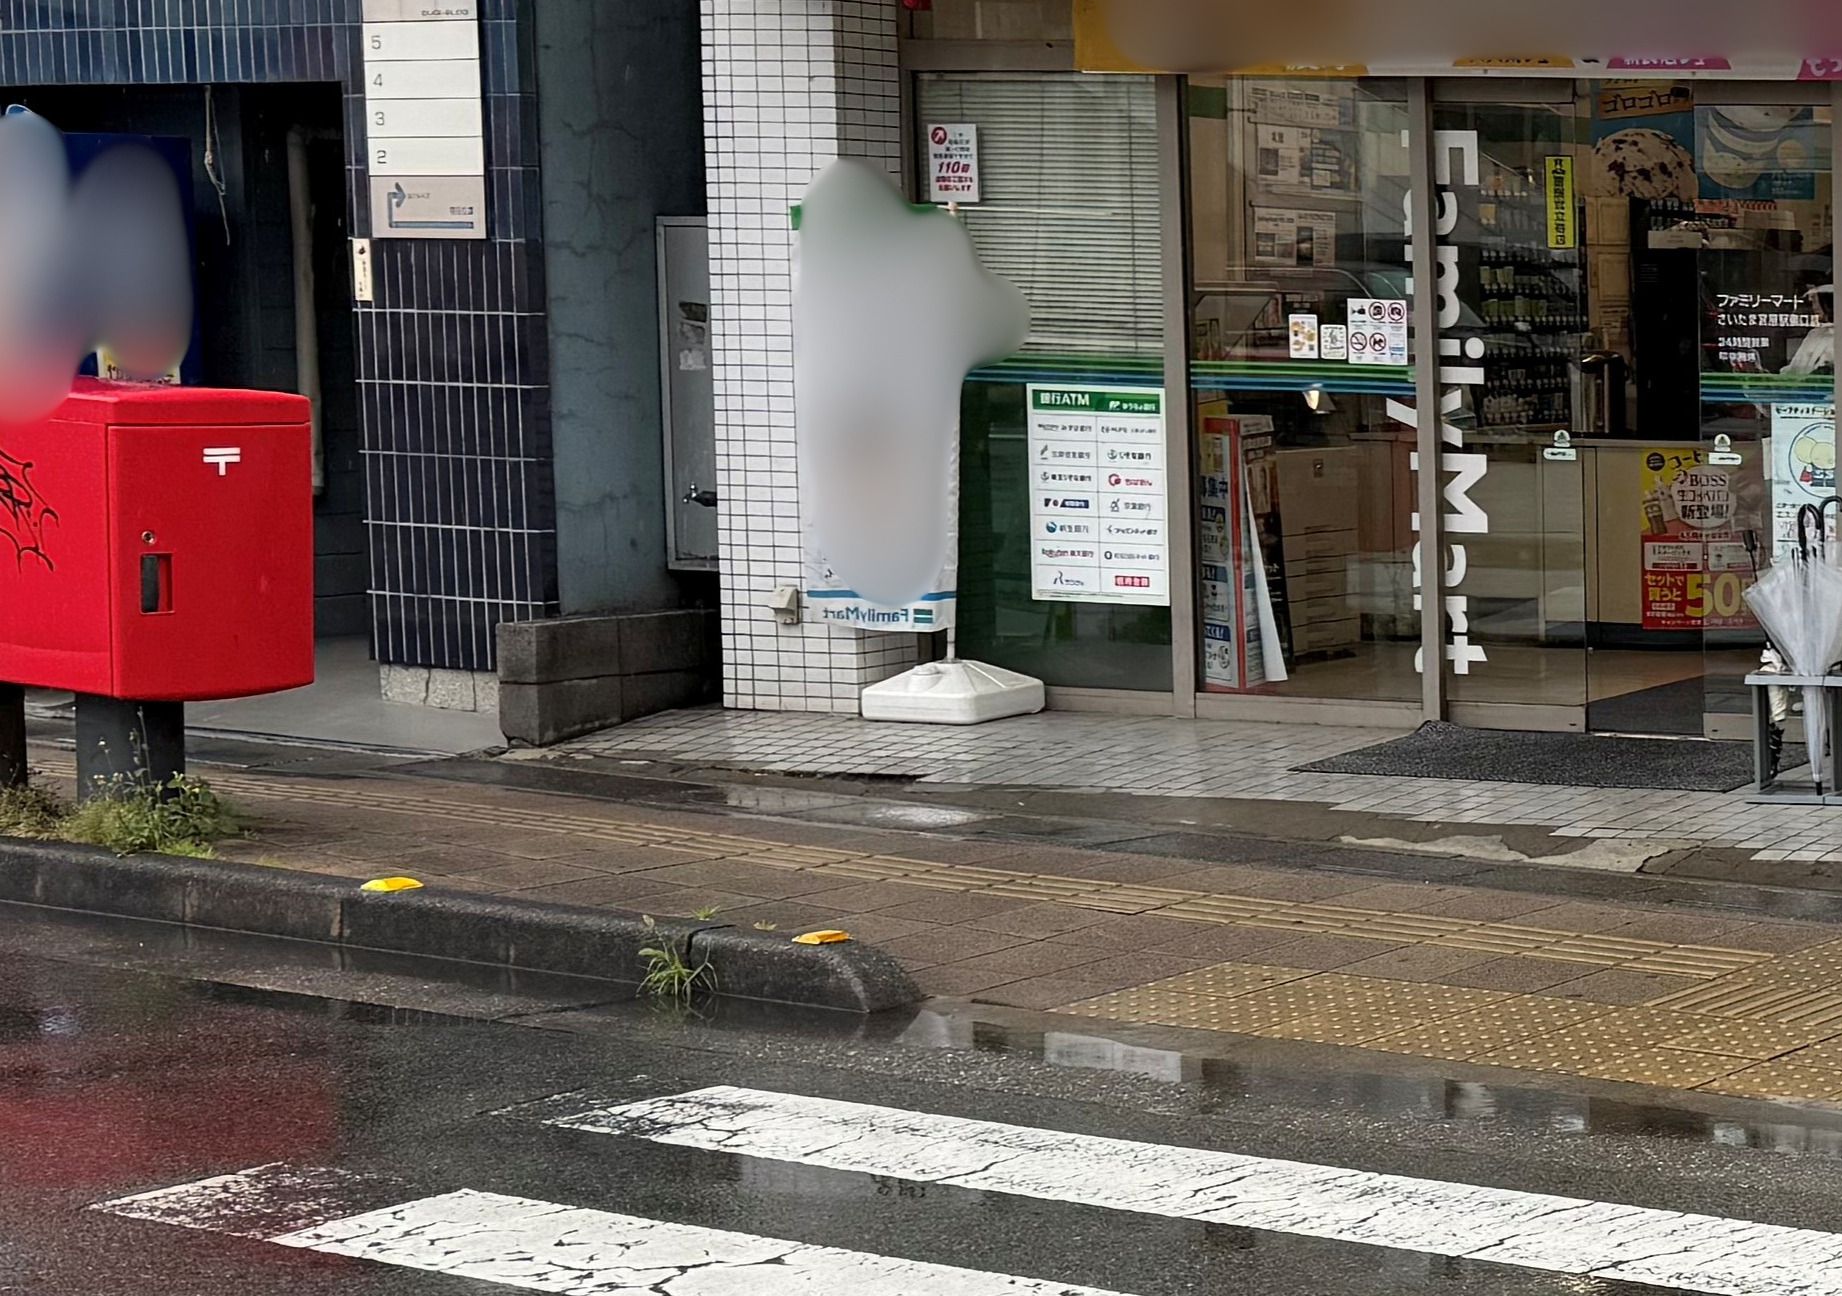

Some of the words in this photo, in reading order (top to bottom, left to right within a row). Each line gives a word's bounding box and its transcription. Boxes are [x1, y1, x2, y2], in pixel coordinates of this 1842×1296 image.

[370, 35, 382, 50] 5
[372, 74, 383, 87] 4
[375, 111, 385, 126] 3
[376, 150, 387, 164] 2
[1716, 294, 1804, 311] ファミリーマート
